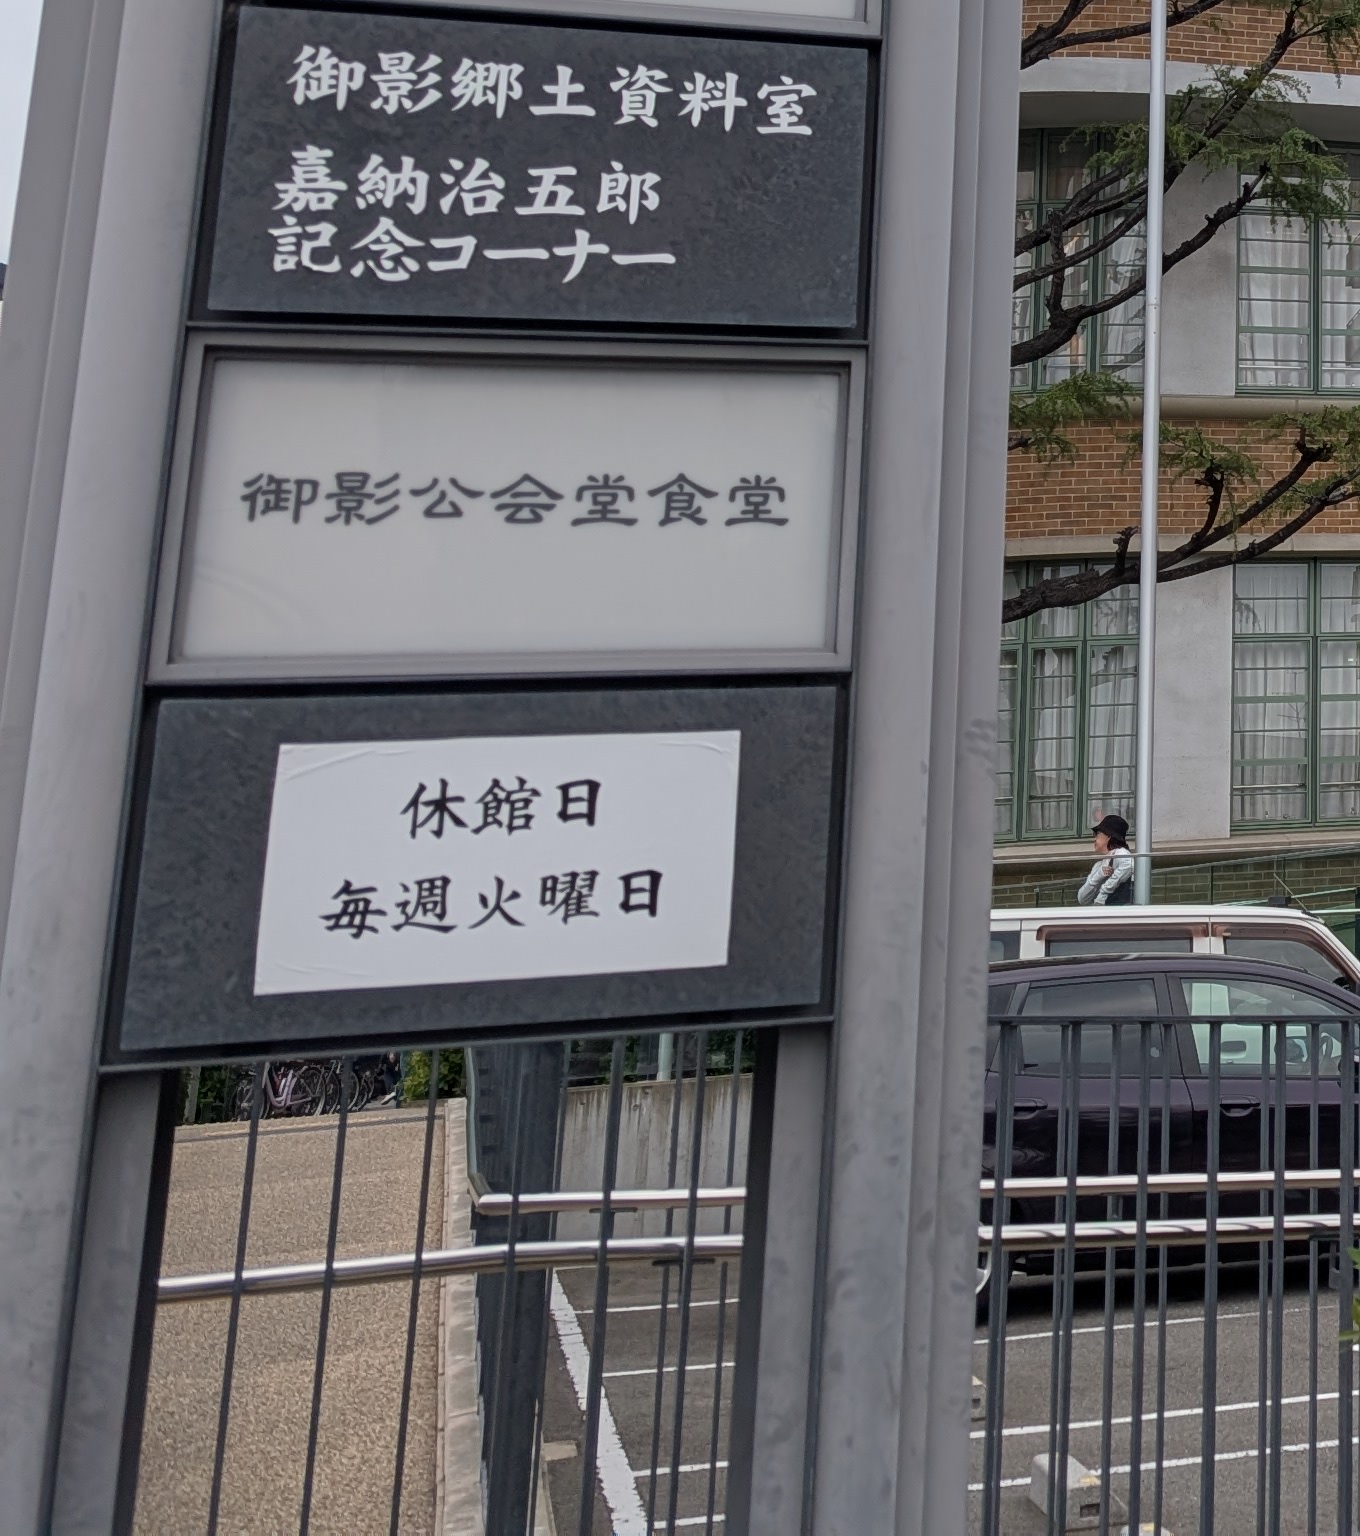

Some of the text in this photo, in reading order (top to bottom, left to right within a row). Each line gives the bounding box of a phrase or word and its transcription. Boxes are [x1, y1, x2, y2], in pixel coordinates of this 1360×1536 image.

[287, 45, 817, 135] 御影郷土資料室
[273, 145, 661, 224] 嘉納治五郎
[268, 215, 676, 283] 記念コーナー
[240, 472, 788, 527] 御影公会堂食堂
[401, 777, 601, 839] 休館日
[320, 870, 662, 939] 毎週火曜日
